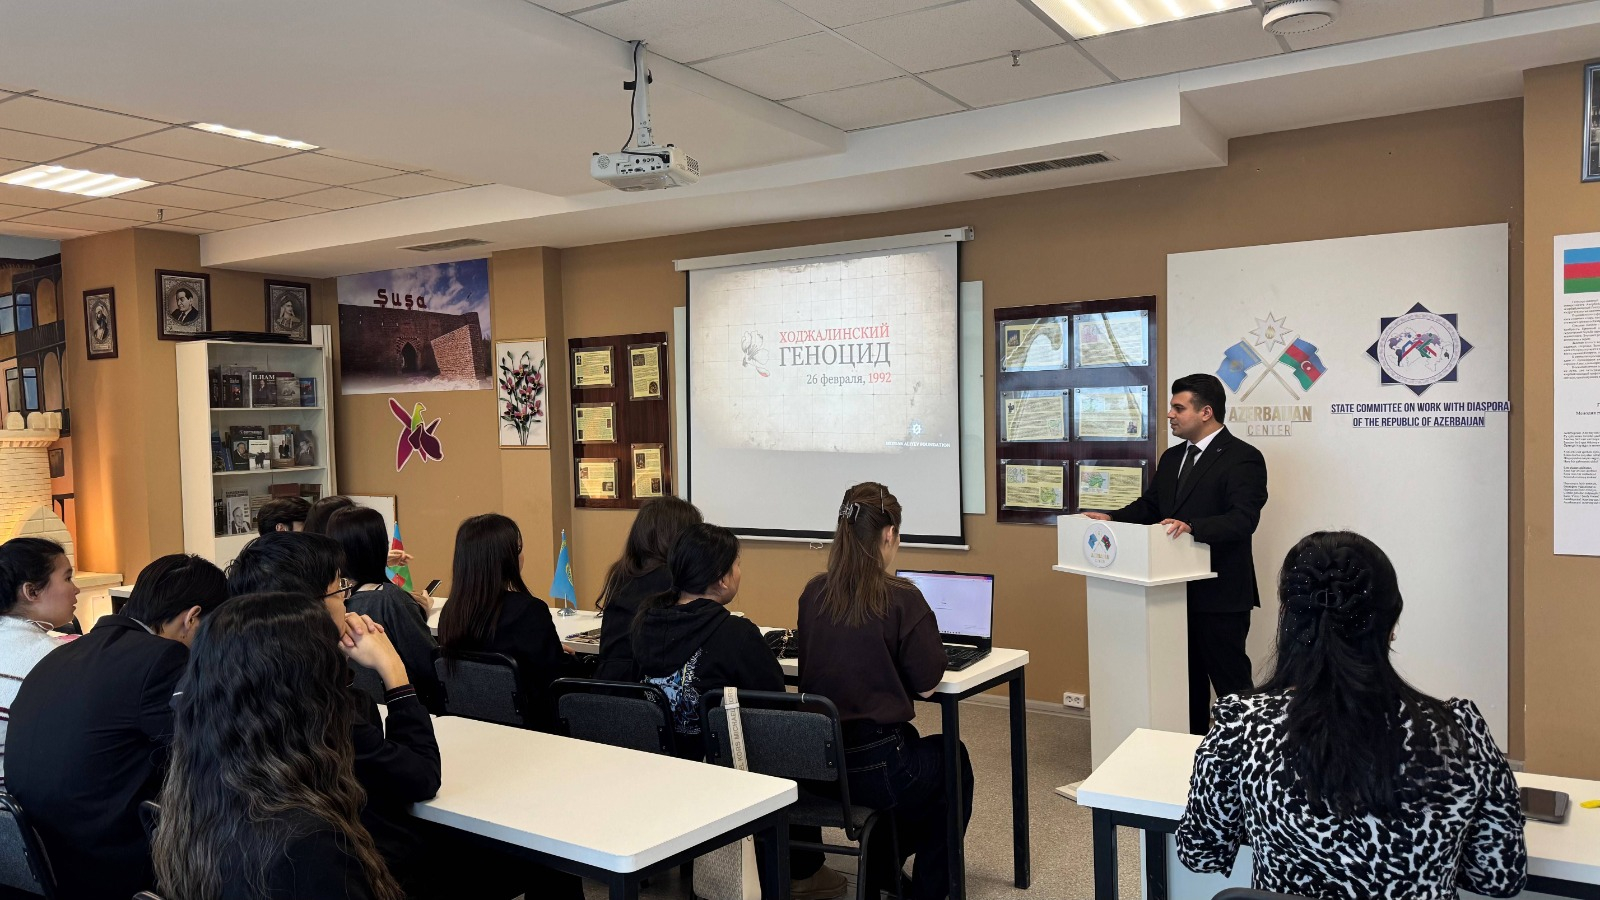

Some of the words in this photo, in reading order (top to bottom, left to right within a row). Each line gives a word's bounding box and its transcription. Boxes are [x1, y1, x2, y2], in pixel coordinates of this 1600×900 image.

[373, 288, 428, 310] Şuşa
[779, 323, 890, 344] ХОДЖАЛИНСКИЙ
[779, 342, 891, 369] ГЕНОЦИД
[806, 373, 818, 385] 26
[820, 373, 866, 387] февраля,
[868, 372, 892, 384] 1992
[1331, 403, 1355, 413] STATE
[1356, 402, 1403, 413] COMMITTEE
[1404, 402, 1415, 412] ON
[1416, 402, 1442, 412] WORK
[1443, 401, 1465, 412] WITH
[1466, 401, 1510, 411] DIASPORA
[1247, 424, 1291, 436] CENTER
[1353, 417, 1363, 427] OF
[1364, 417, 1380, 427] THE
[1381, 416, 1420, 427] REPUBLIC
[1421, 416, 1432, 426] OF
[1433, 416, 1485, 426] AZERBAIJAN
[730, 708, 739, 740] MICHAEL
[735, 741, 743, 762] KORS
